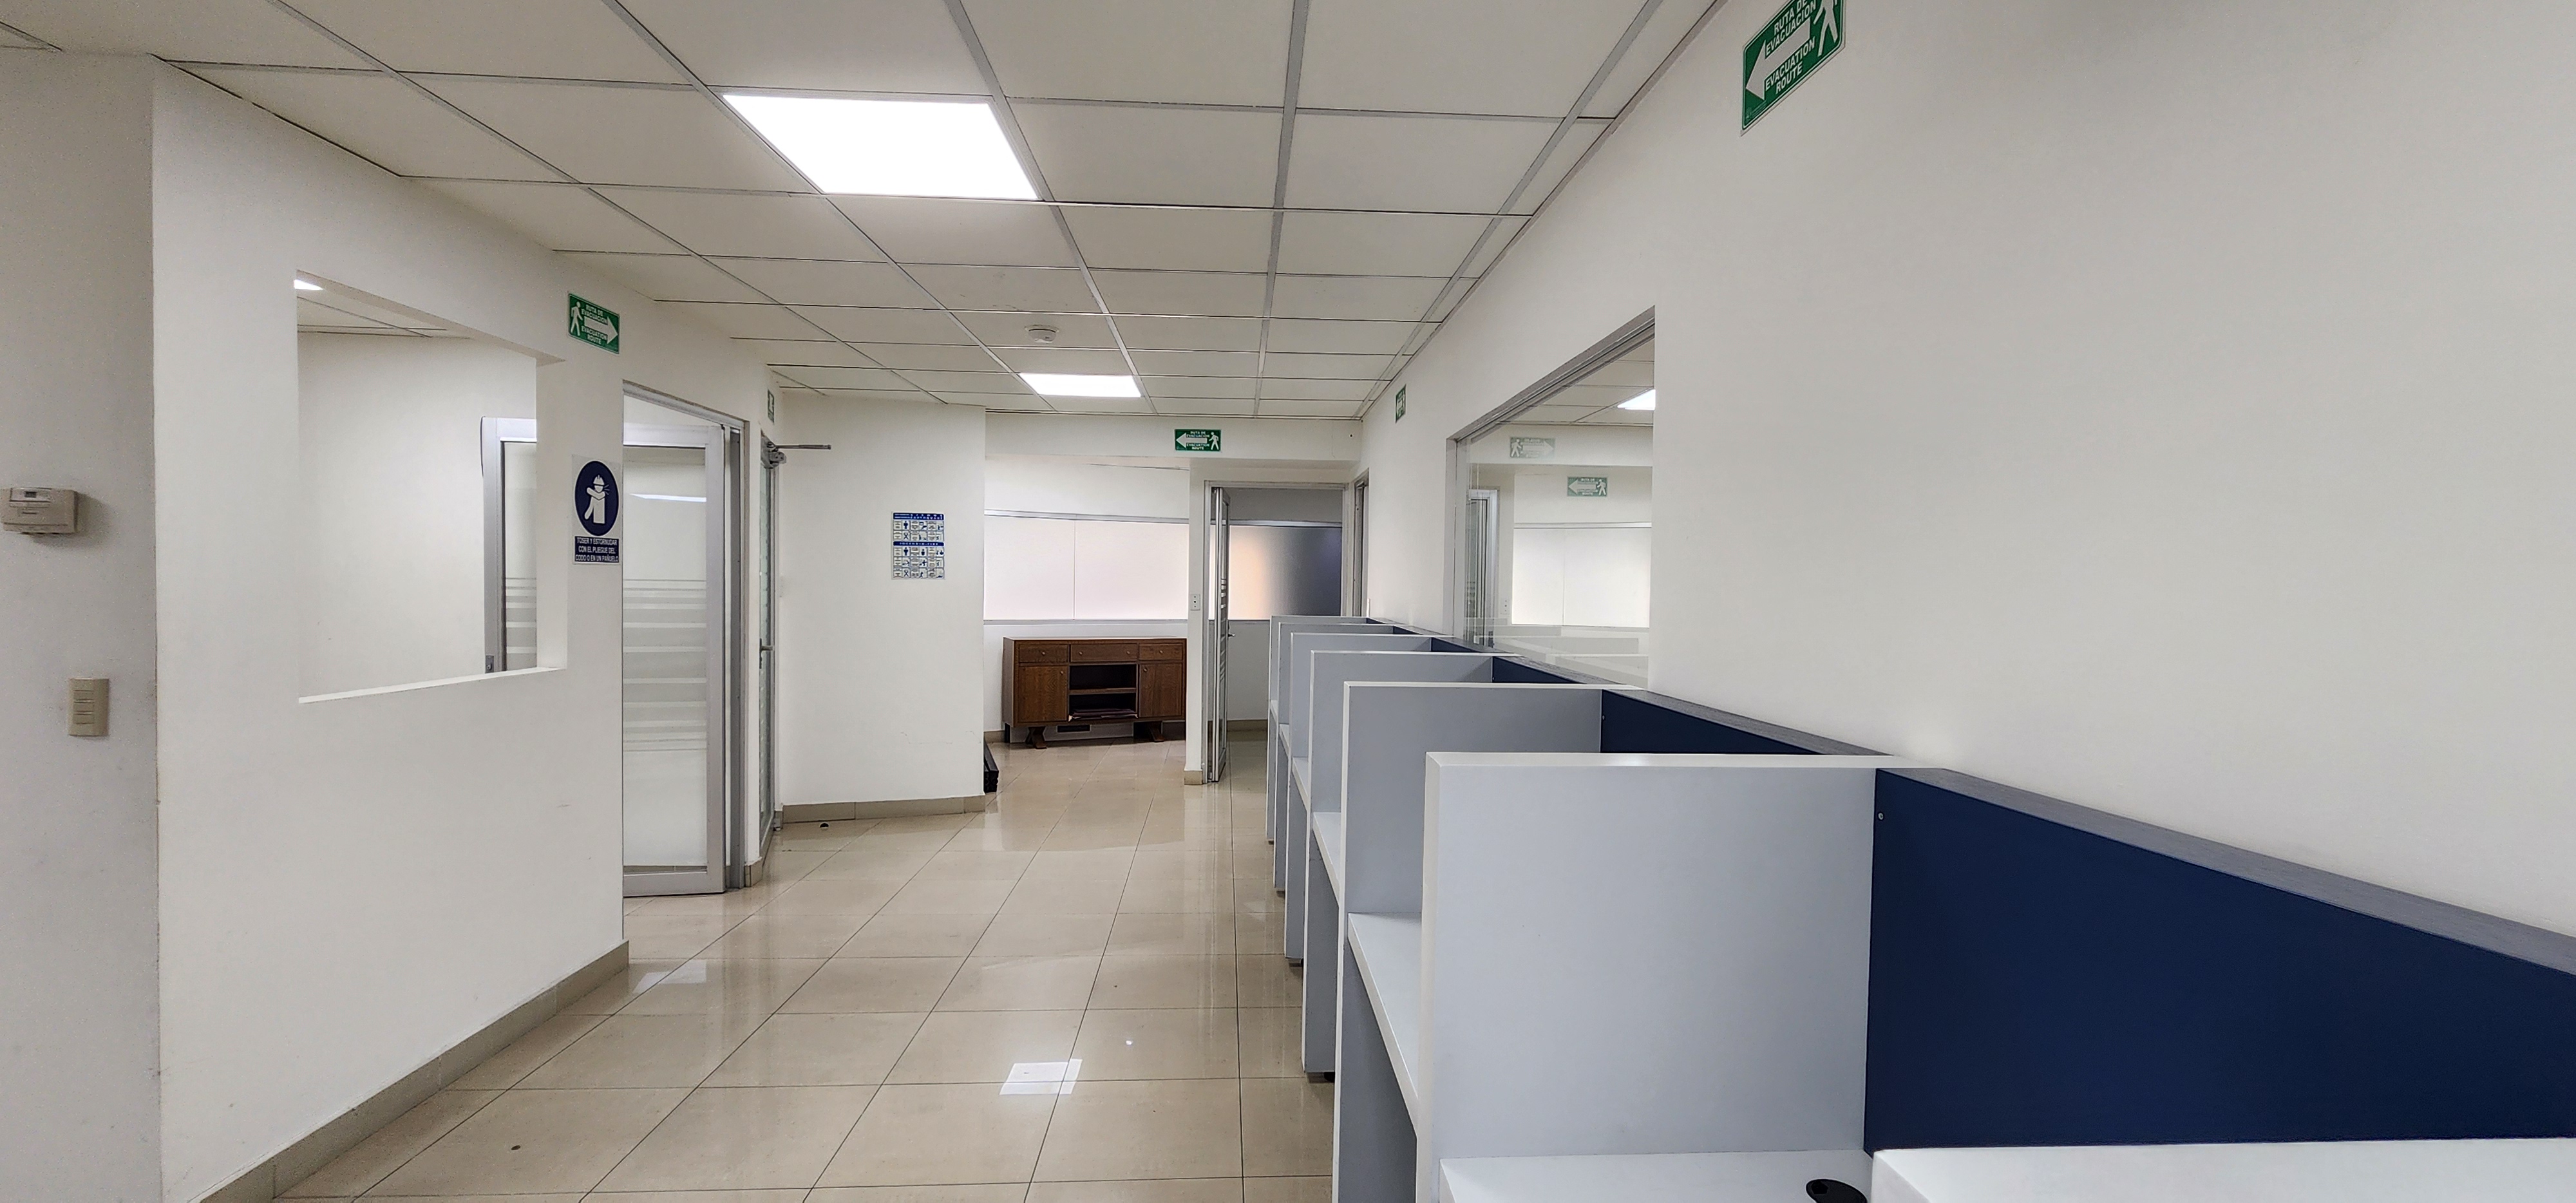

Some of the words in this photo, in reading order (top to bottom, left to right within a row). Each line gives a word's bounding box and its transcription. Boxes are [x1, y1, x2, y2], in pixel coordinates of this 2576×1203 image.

[1774, 7, 1795, 35] RUTA
[1765, 36, 1815, 91] EVACUATION
[1776, 61, 1803, 95] ROUTE
